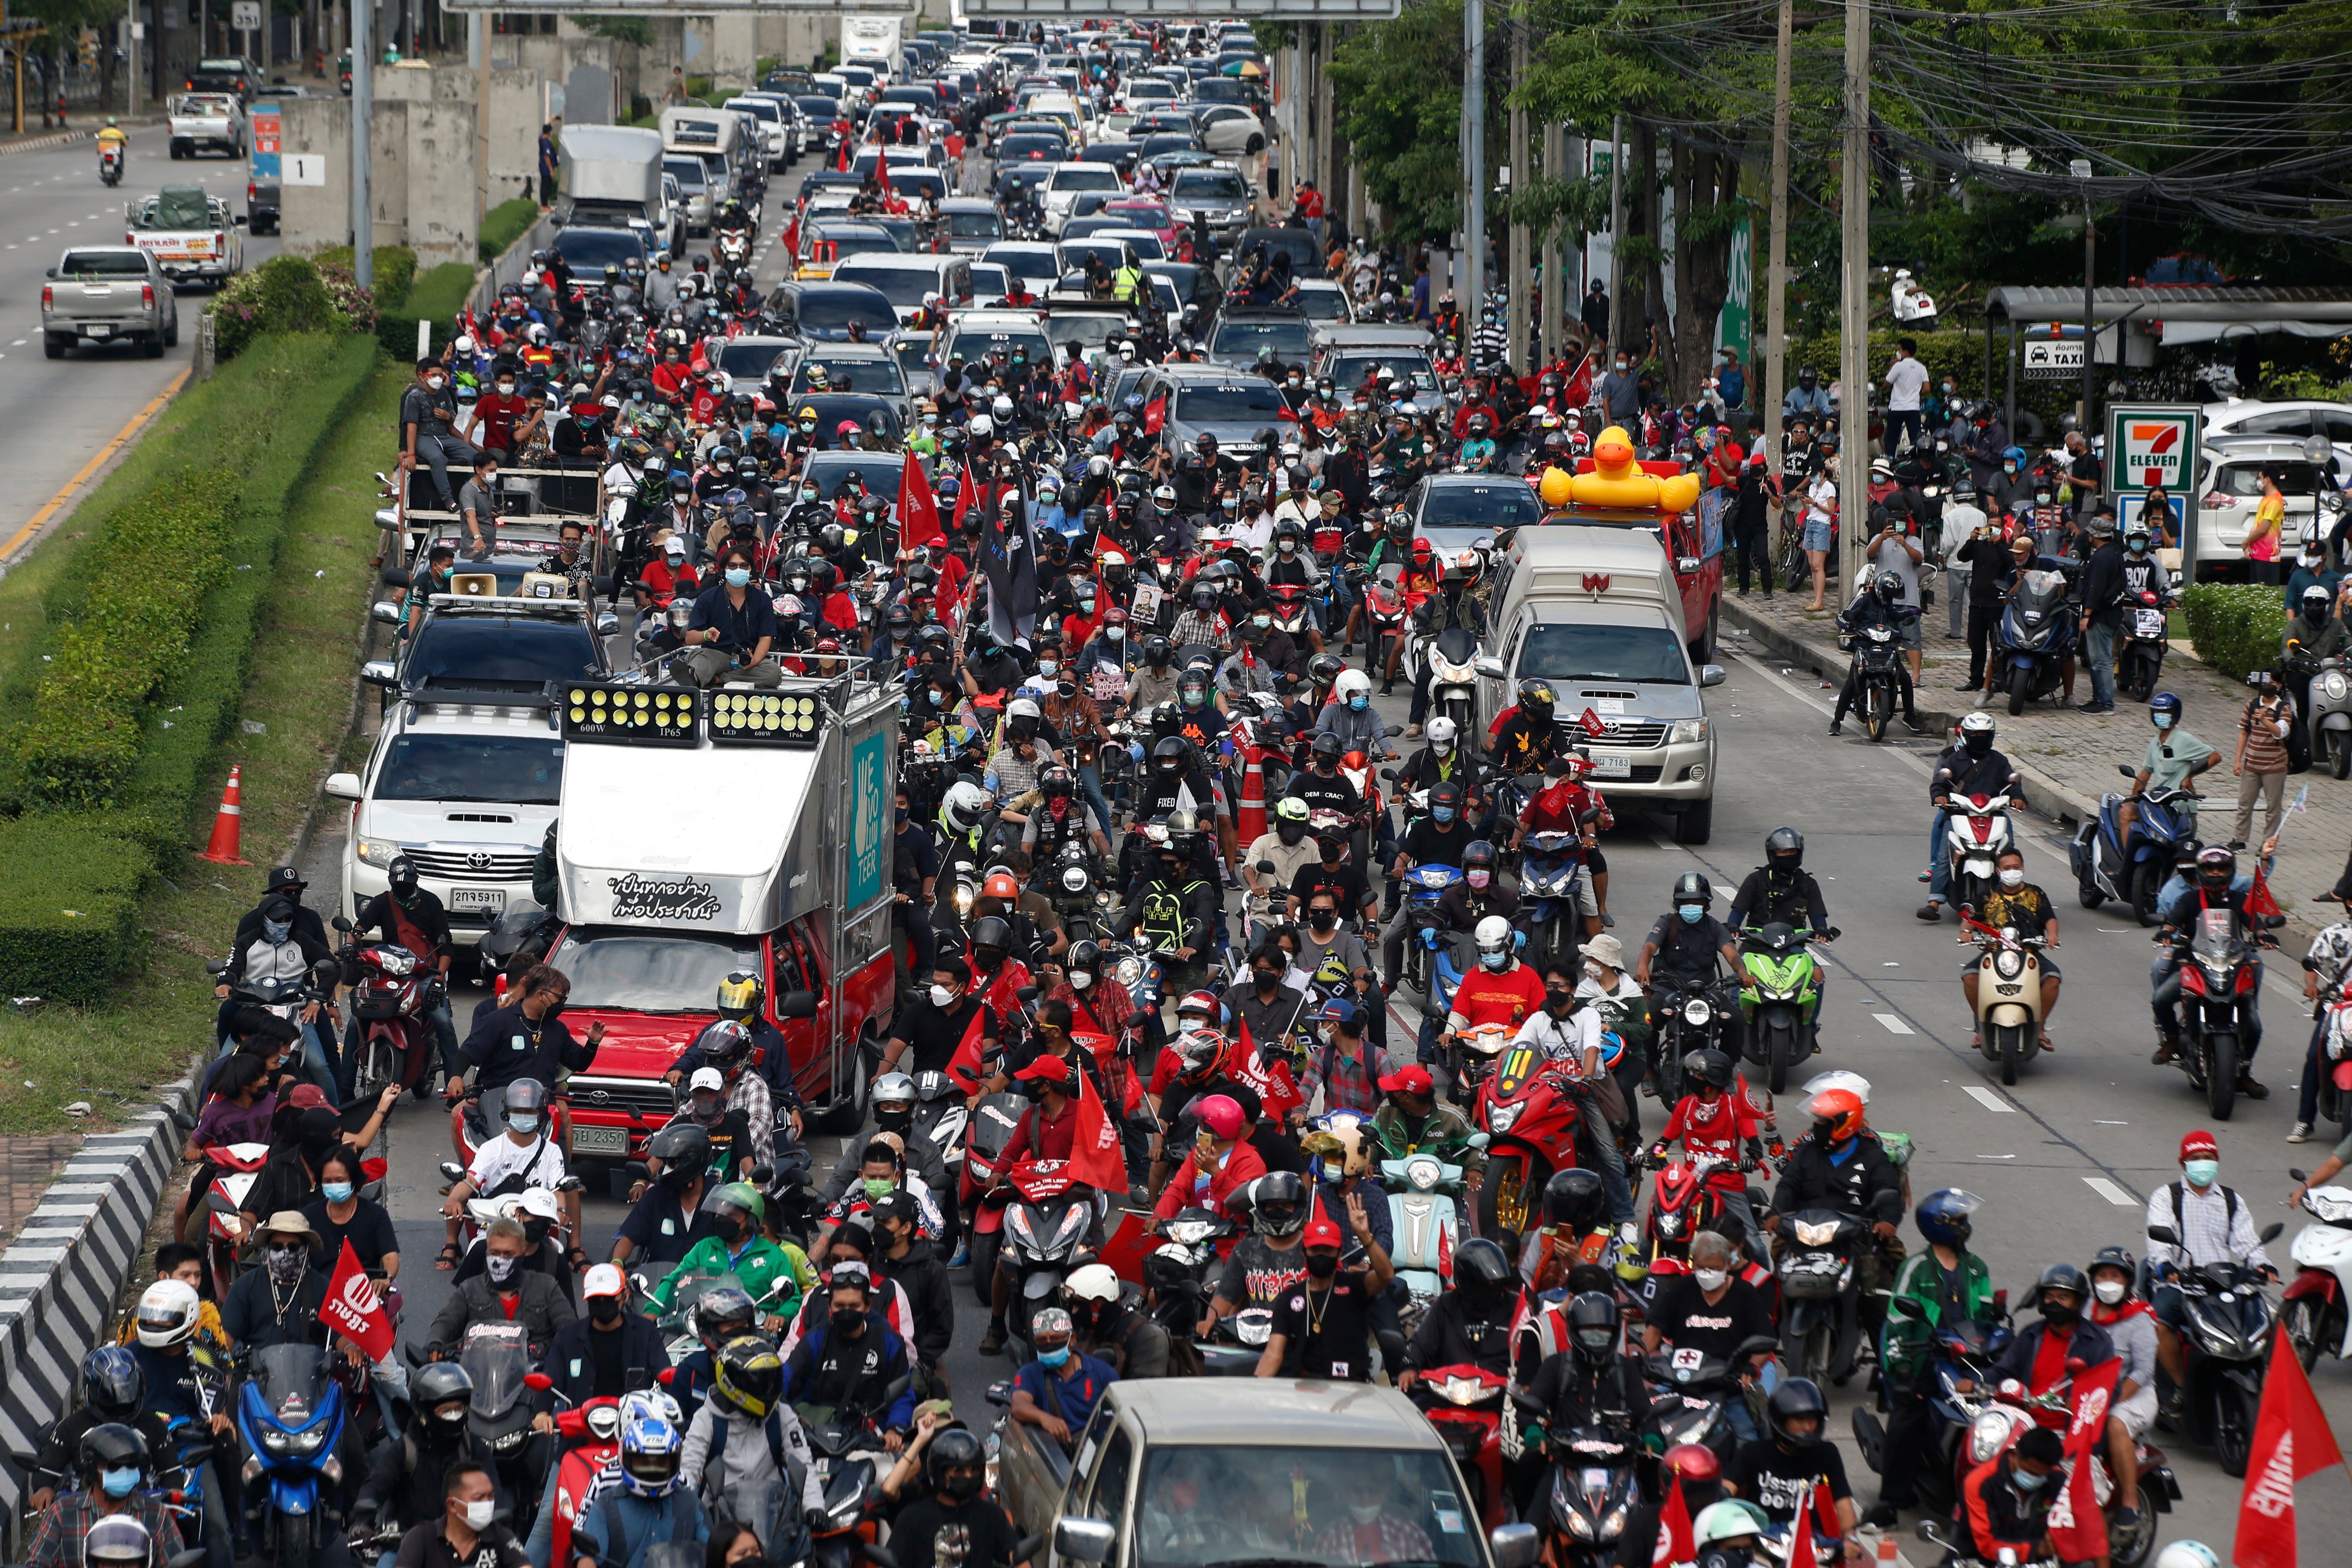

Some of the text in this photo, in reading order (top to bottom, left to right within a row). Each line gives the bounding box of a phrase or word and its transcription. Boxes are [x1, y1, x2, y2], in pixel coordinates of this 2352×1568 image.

[298, 160, 303, 179] 1
[2054, 354, 2083, 364] TAXI
[1787, 451, 1808, 460] CHICAGO
[2133, 425, 2177, 486] 7
[2127, 567, 2150, 587] BOY
[2025, 610, 2041, 618] PRESS
[580, 725, 606, 733] 600W
[660, 728, 681, 737] IP65
[1609, 759, 1628, 767] 7183
[1157, 797, 1176, 808] FIXED
[865, 819, 878, 852] LUN
[858, 852, 876, 887] TEER
[594, 1128, 624, 1144] 2350
[1587, 1247, 1600, 1259] 27
[328, 1298, 371, 1334] ราษฎร
